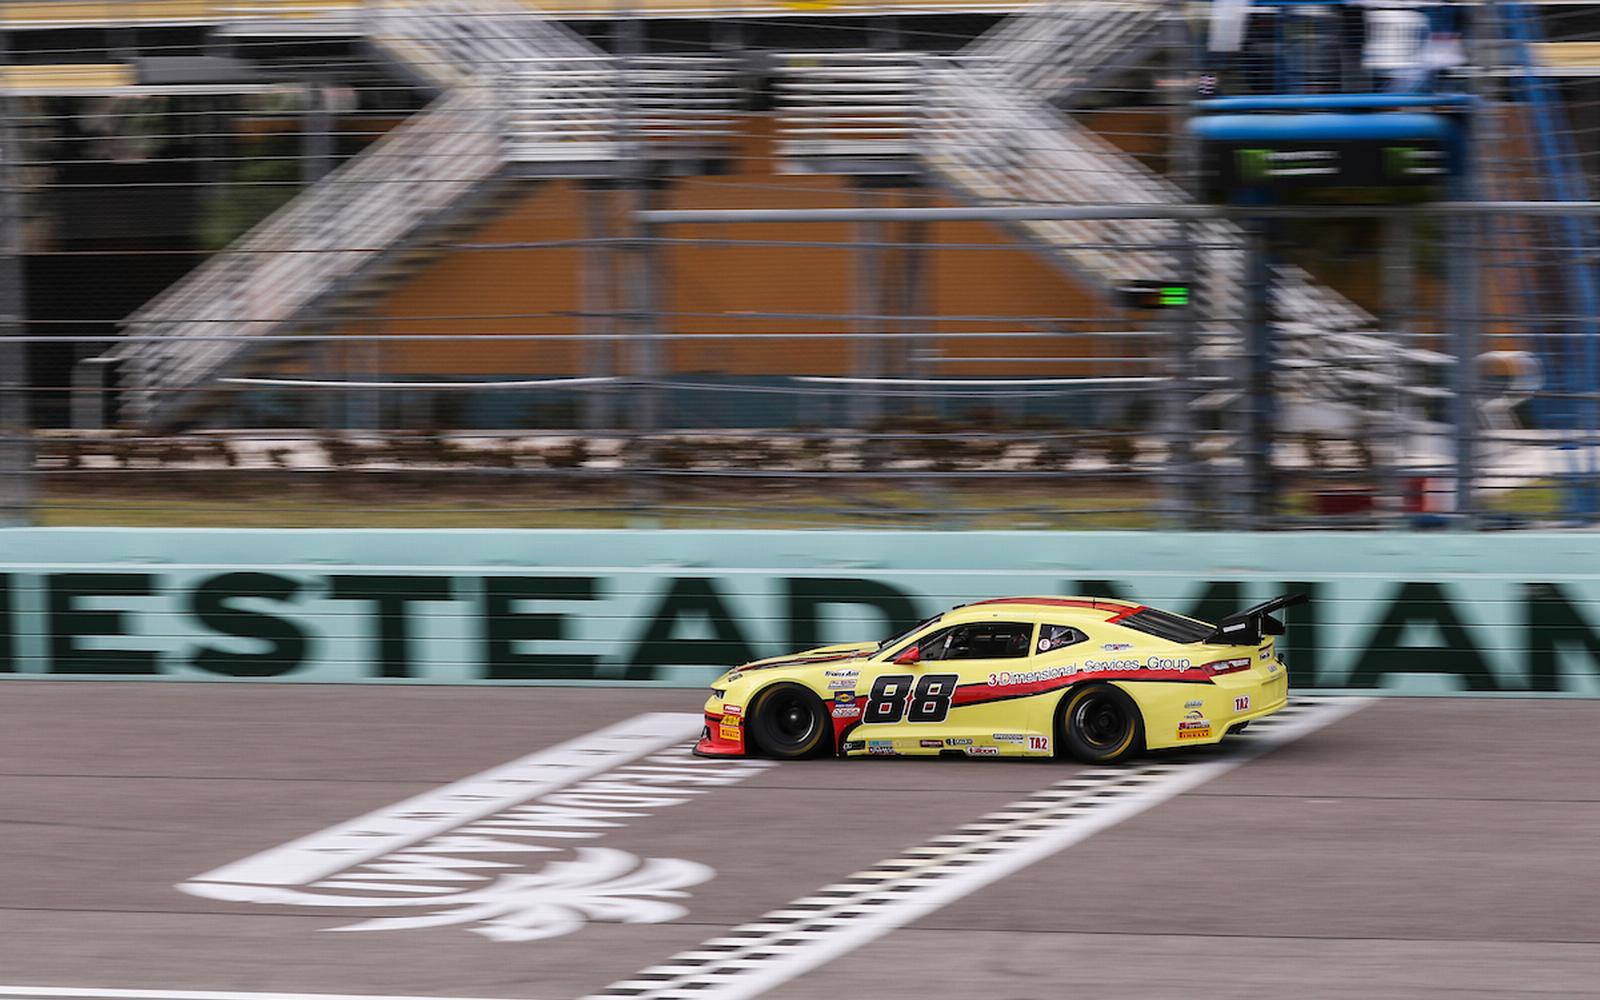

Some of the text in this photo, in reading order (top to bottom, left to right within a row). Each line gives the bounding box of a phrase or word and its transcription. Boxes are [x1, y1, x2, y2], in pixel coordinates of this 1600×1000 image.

[0, 571, 918, 682] ESTEAD
[1084, 658, 1139, 672] Services
[1147, 655, 1191, 672] Group
[862, 674, 959, 724] 88
[1235, 697, 1249, 710] TA2
[1030, 737, 1047, 750] TA2
